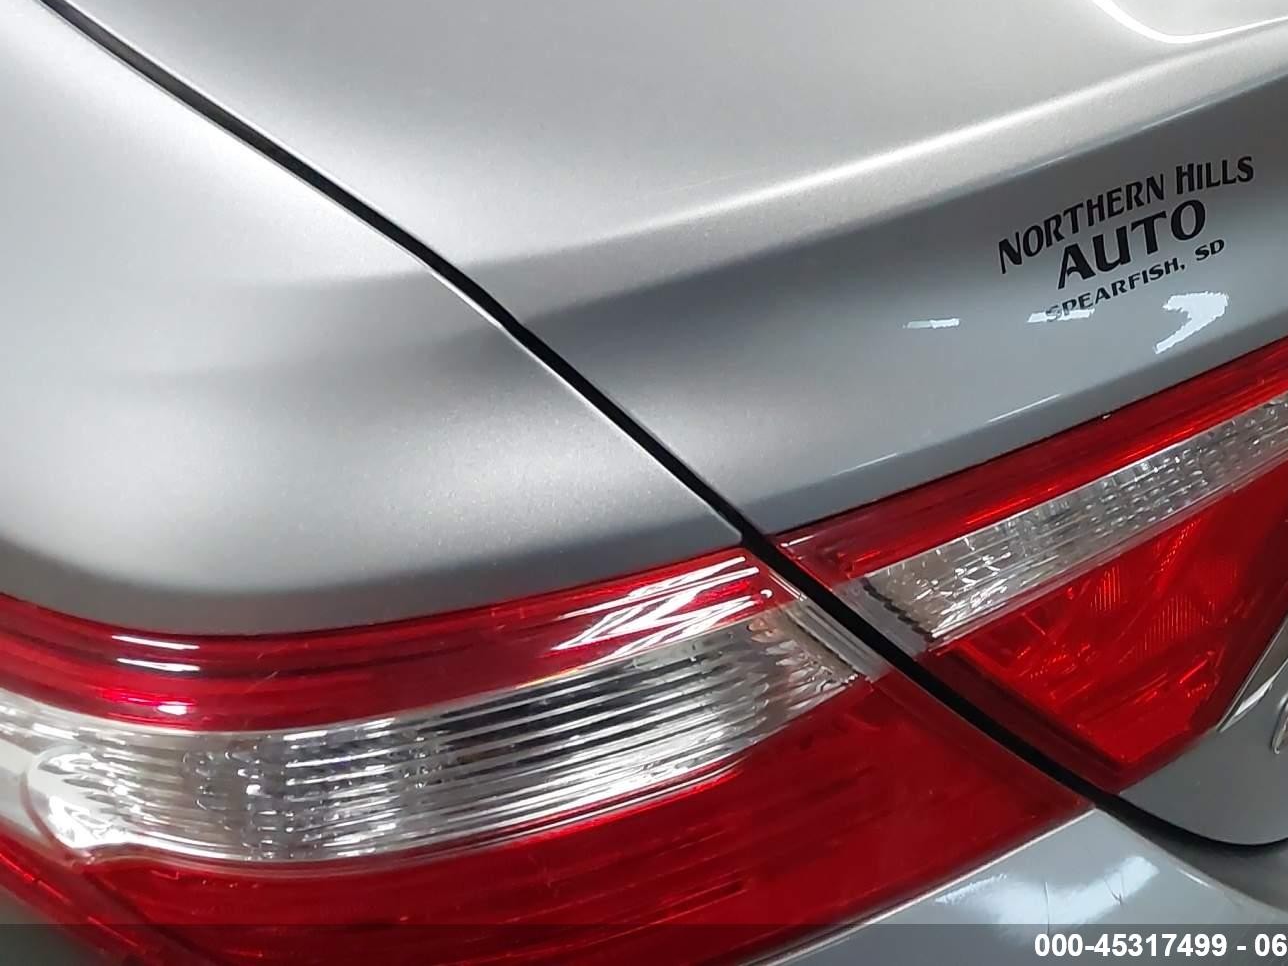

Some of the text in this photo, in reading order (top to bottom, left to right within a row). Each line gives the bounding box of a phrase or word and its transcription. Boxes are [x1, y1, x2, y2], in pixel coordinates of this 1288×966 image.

[998, 156, 1254, 274] NORTHERN HILLS
[1057, 199, 1206, 290] AUTO
[1045, 239, 1225, 322] SPEARFISH, SD
